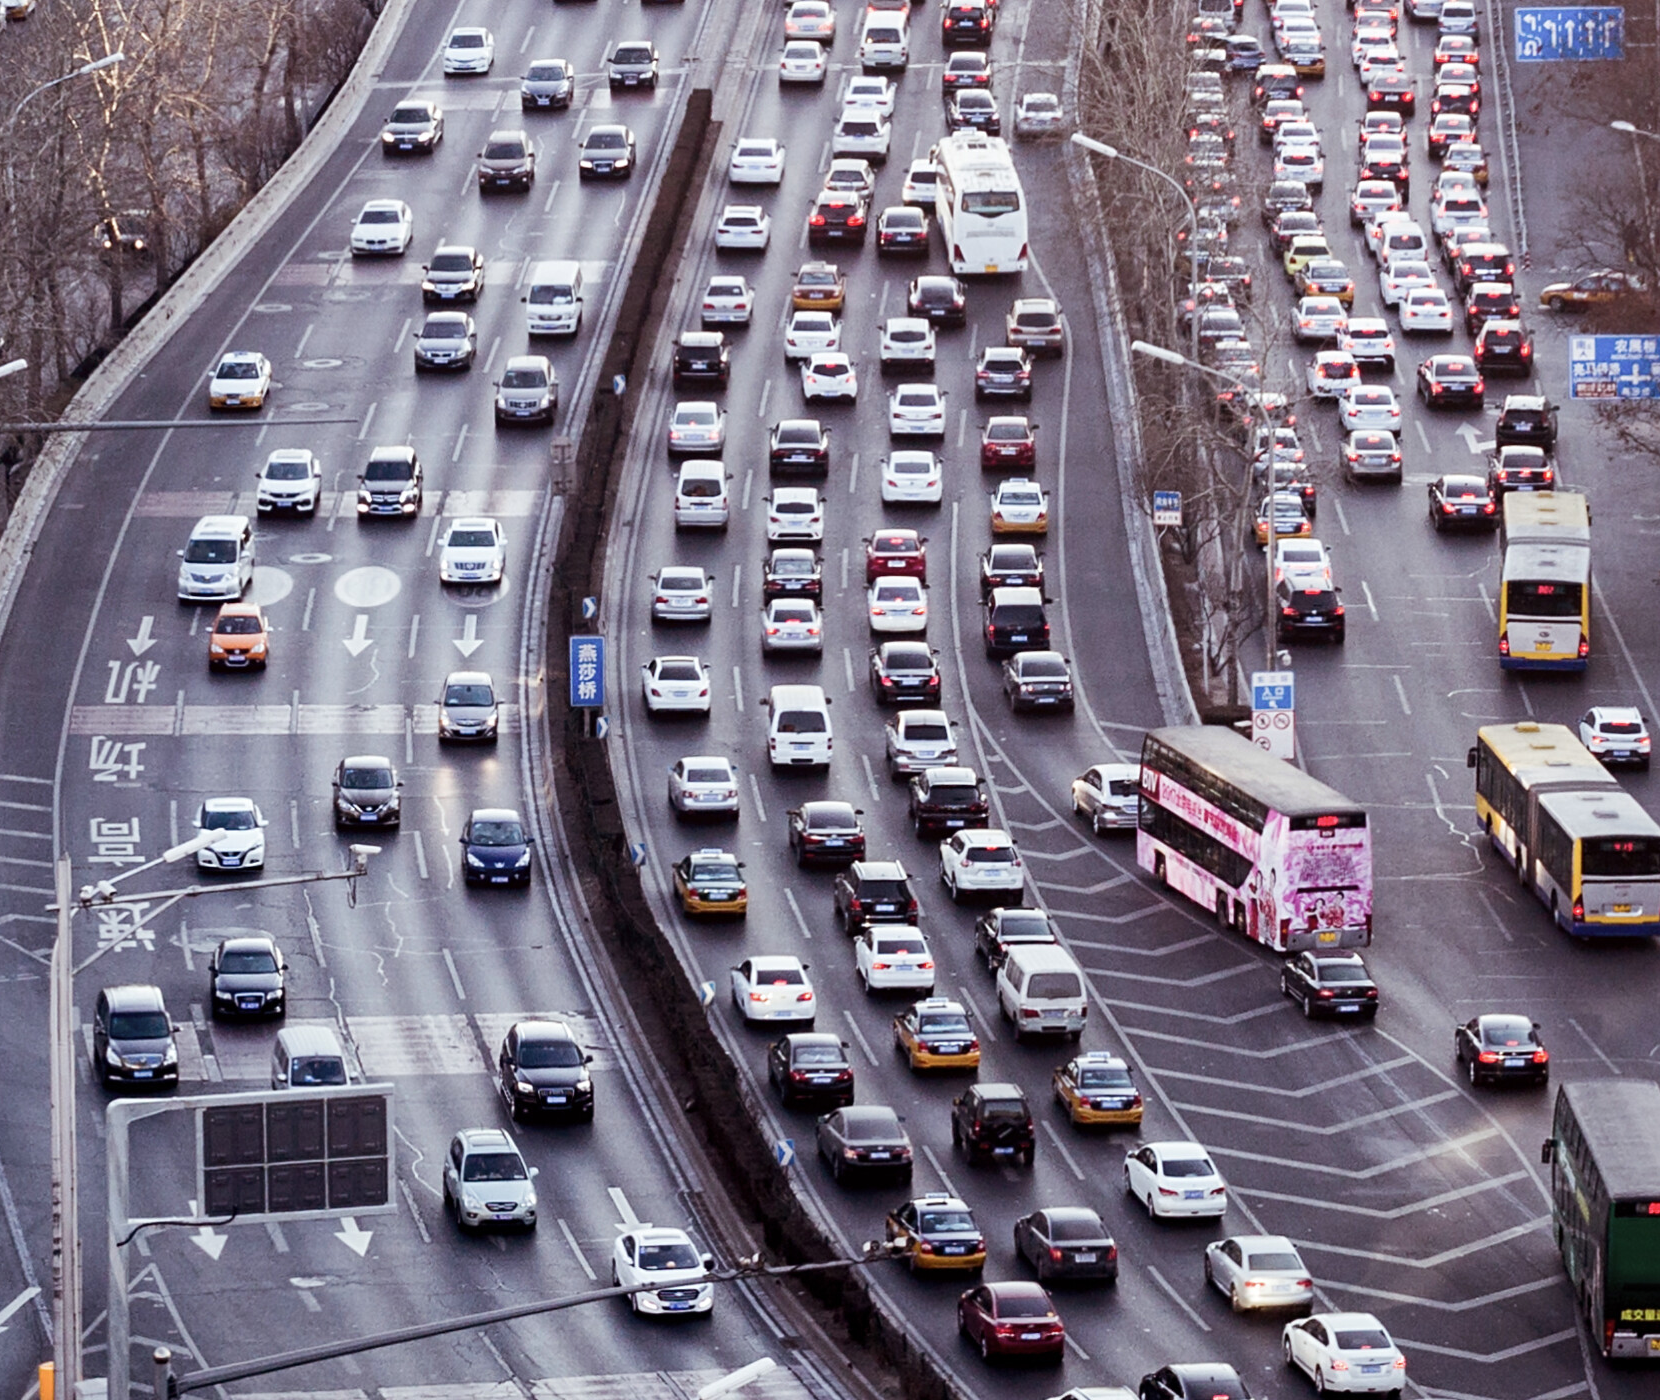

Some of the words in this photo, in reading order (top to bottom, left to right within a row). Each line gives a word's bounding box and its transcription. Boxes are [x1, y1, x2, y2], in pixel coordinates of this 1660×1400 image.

[577, 643, 598, 700] 燕莎桥
[1262, 687, 1284, 697] 入口
